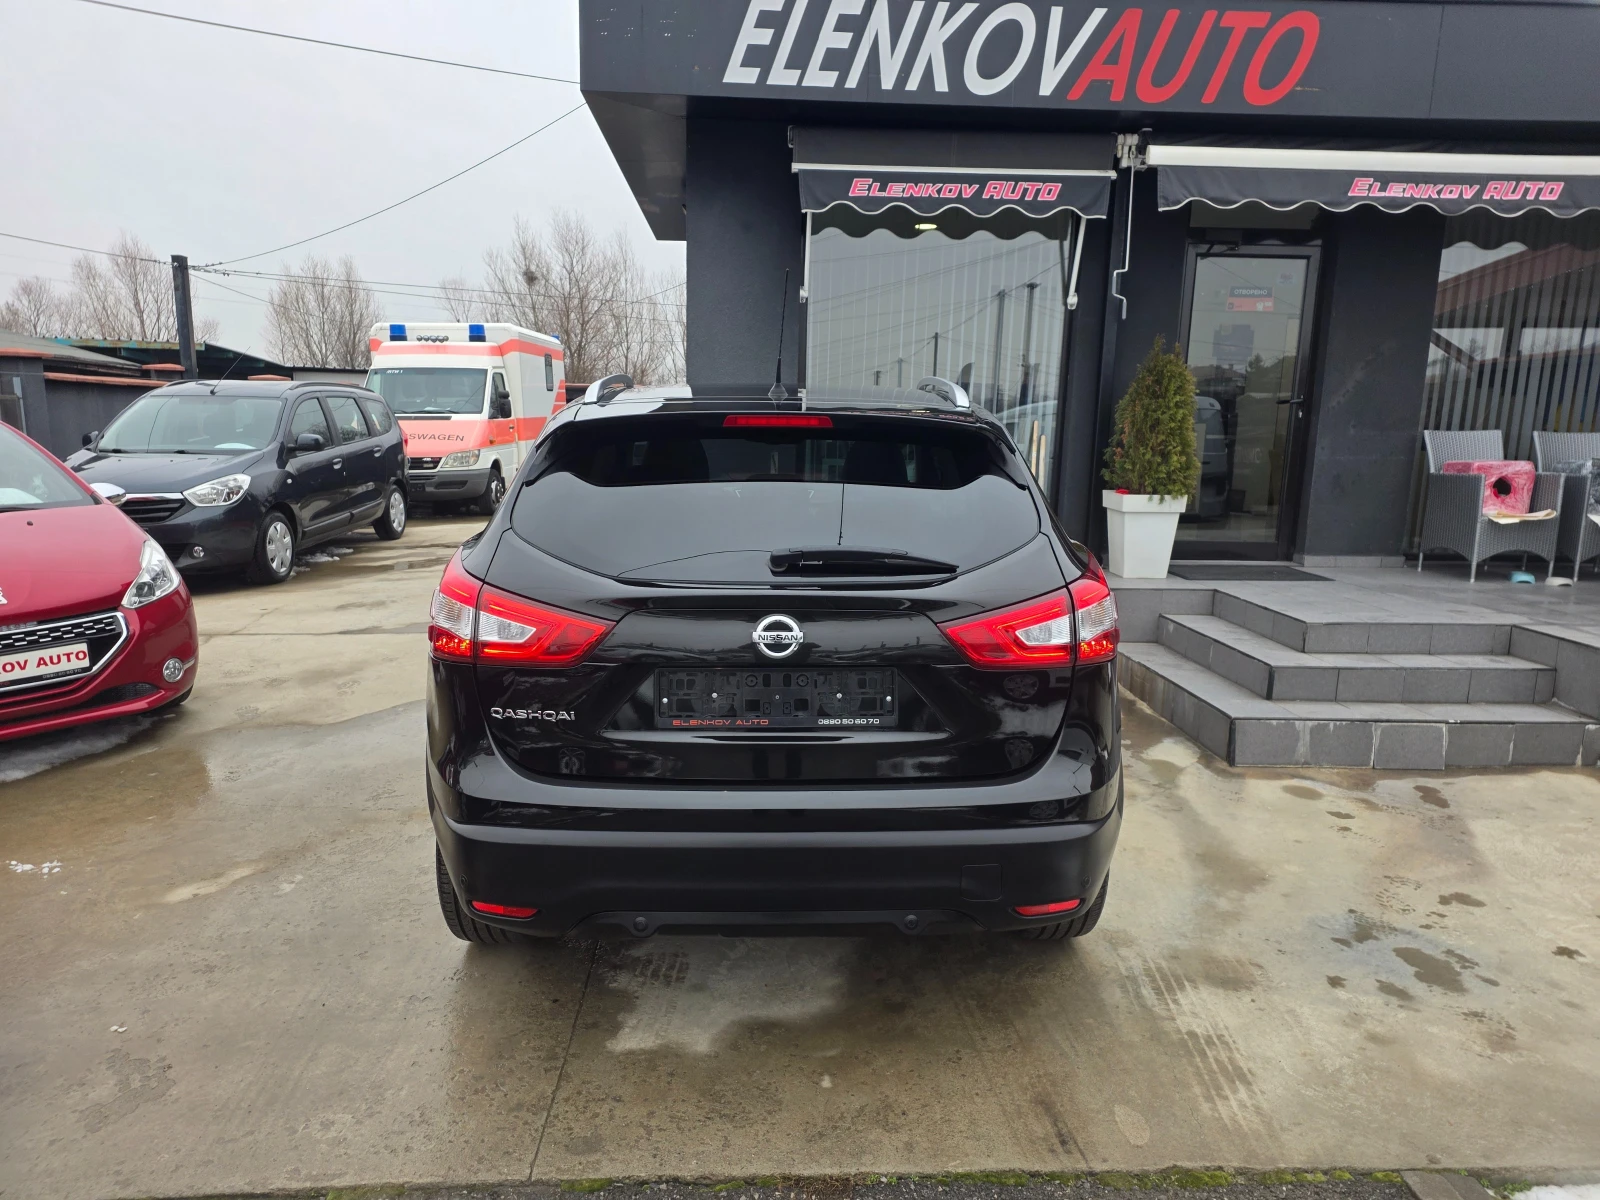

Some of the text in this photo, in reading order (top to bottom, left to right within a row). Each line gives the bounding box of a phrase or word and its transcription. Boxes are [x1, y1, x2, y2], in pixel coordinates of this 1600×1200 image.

[849, 178, 1062, 201] ELENKOV AUTO
[1348, 178, 1564, 201] ELENKOV AUTO
[407, 433, 465, 441] SWAGEN
[0, 650, 88, 675] OV AUTO
